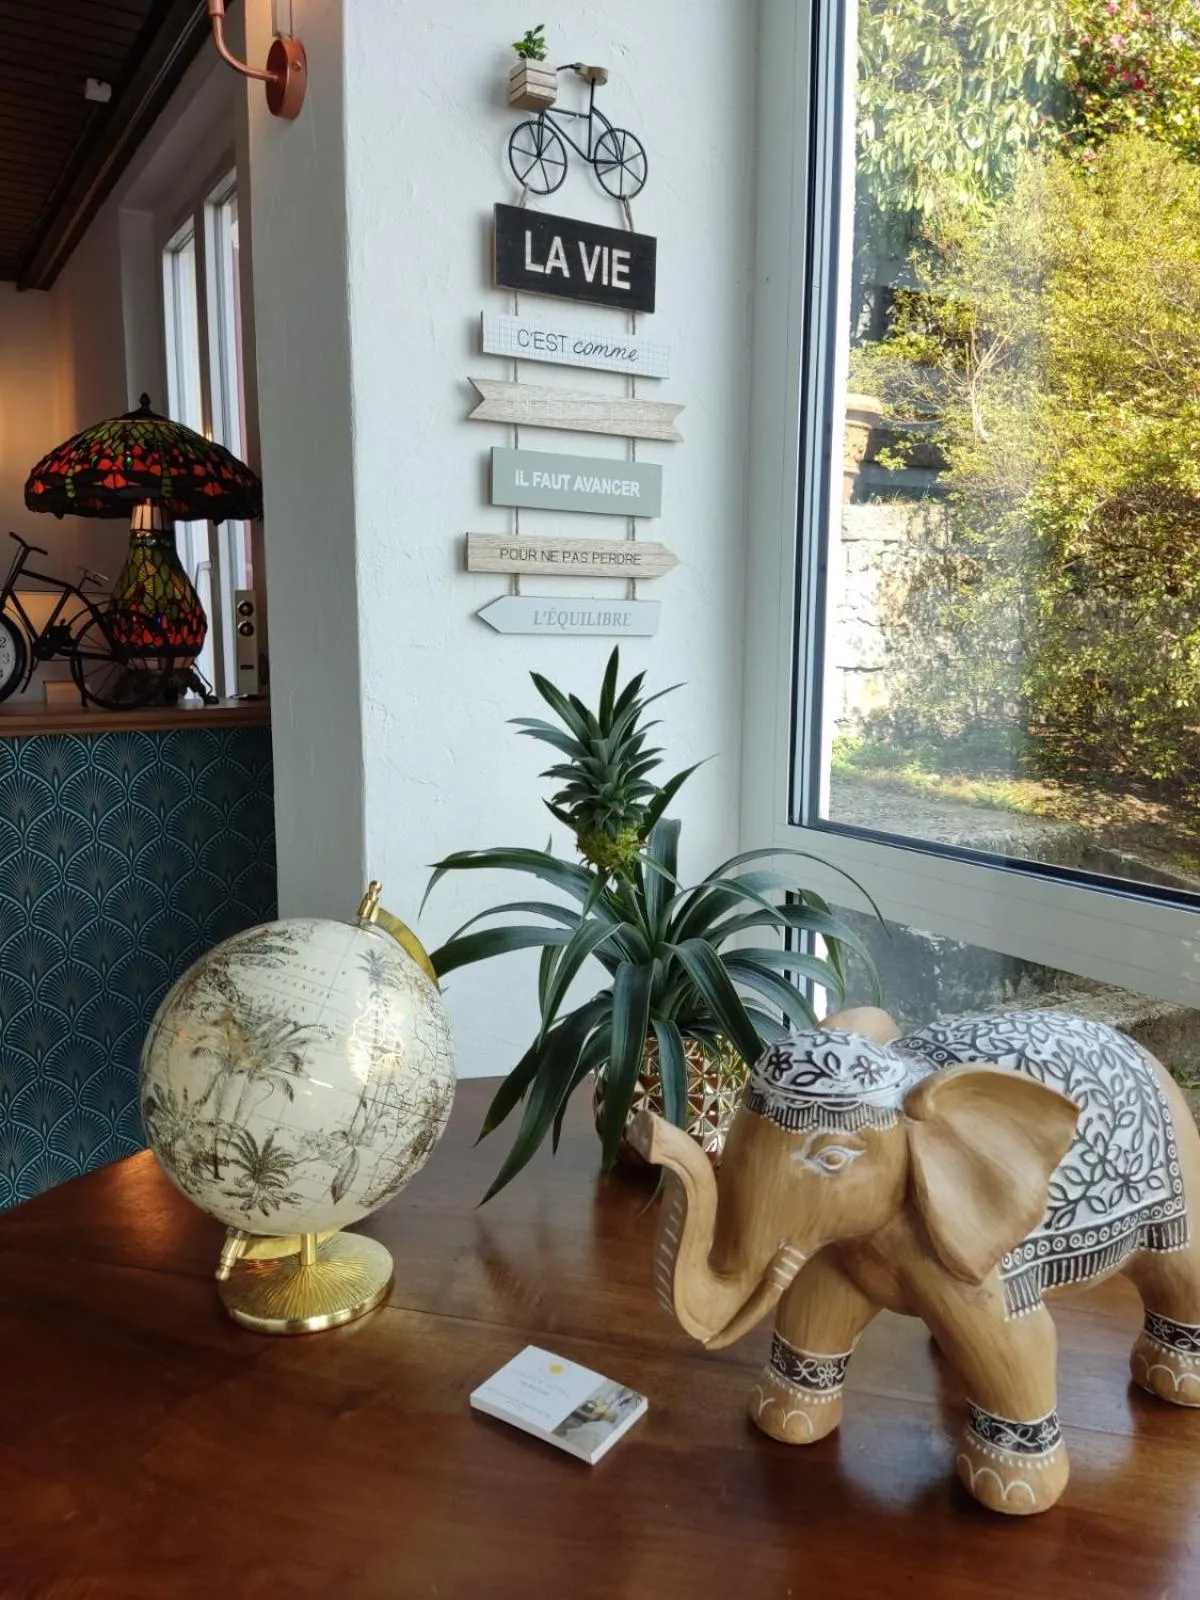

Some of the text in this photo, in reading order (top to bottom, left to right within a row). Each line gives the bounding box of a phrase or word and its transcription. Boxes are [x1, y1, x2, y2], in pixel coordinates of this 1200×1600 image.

[525, 230, 631, 290] LA VIE
[517, 328, 639, 362] C'EST comme
[515, 469, 641, 498] IL FAUT AVANCER
[500, 548, 642, 566] POUR NE PAS PERDRE
[533, 607, 632, 629] L'ÉQUILIBRE
